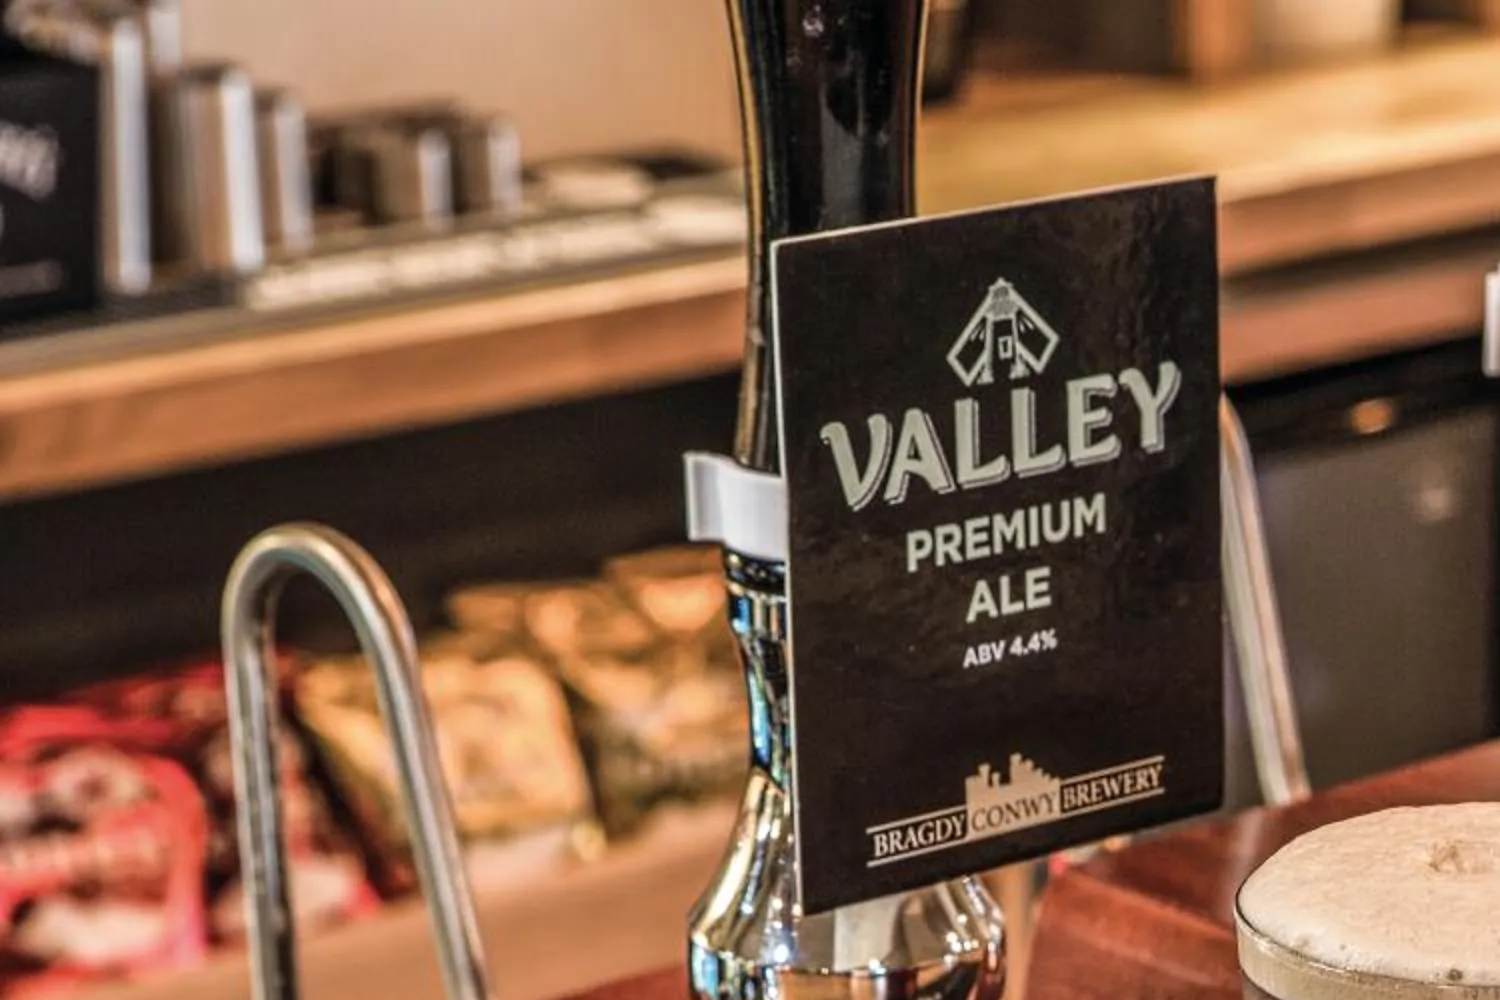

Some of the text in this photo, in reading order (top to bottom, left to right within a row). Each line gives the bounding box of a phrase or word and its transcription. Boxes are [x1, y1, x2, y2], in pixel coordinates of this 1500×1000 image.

[820, 360, 1182, 511] VALLEY
[906, 492, 1107, 573] PREMIUM
[965, 565, 1053, 624] ALE
[962, 627, 1059, 669] ABV 4.4%
[873, 763, 1164, 857] BRAGDY CONWY BREWERY
